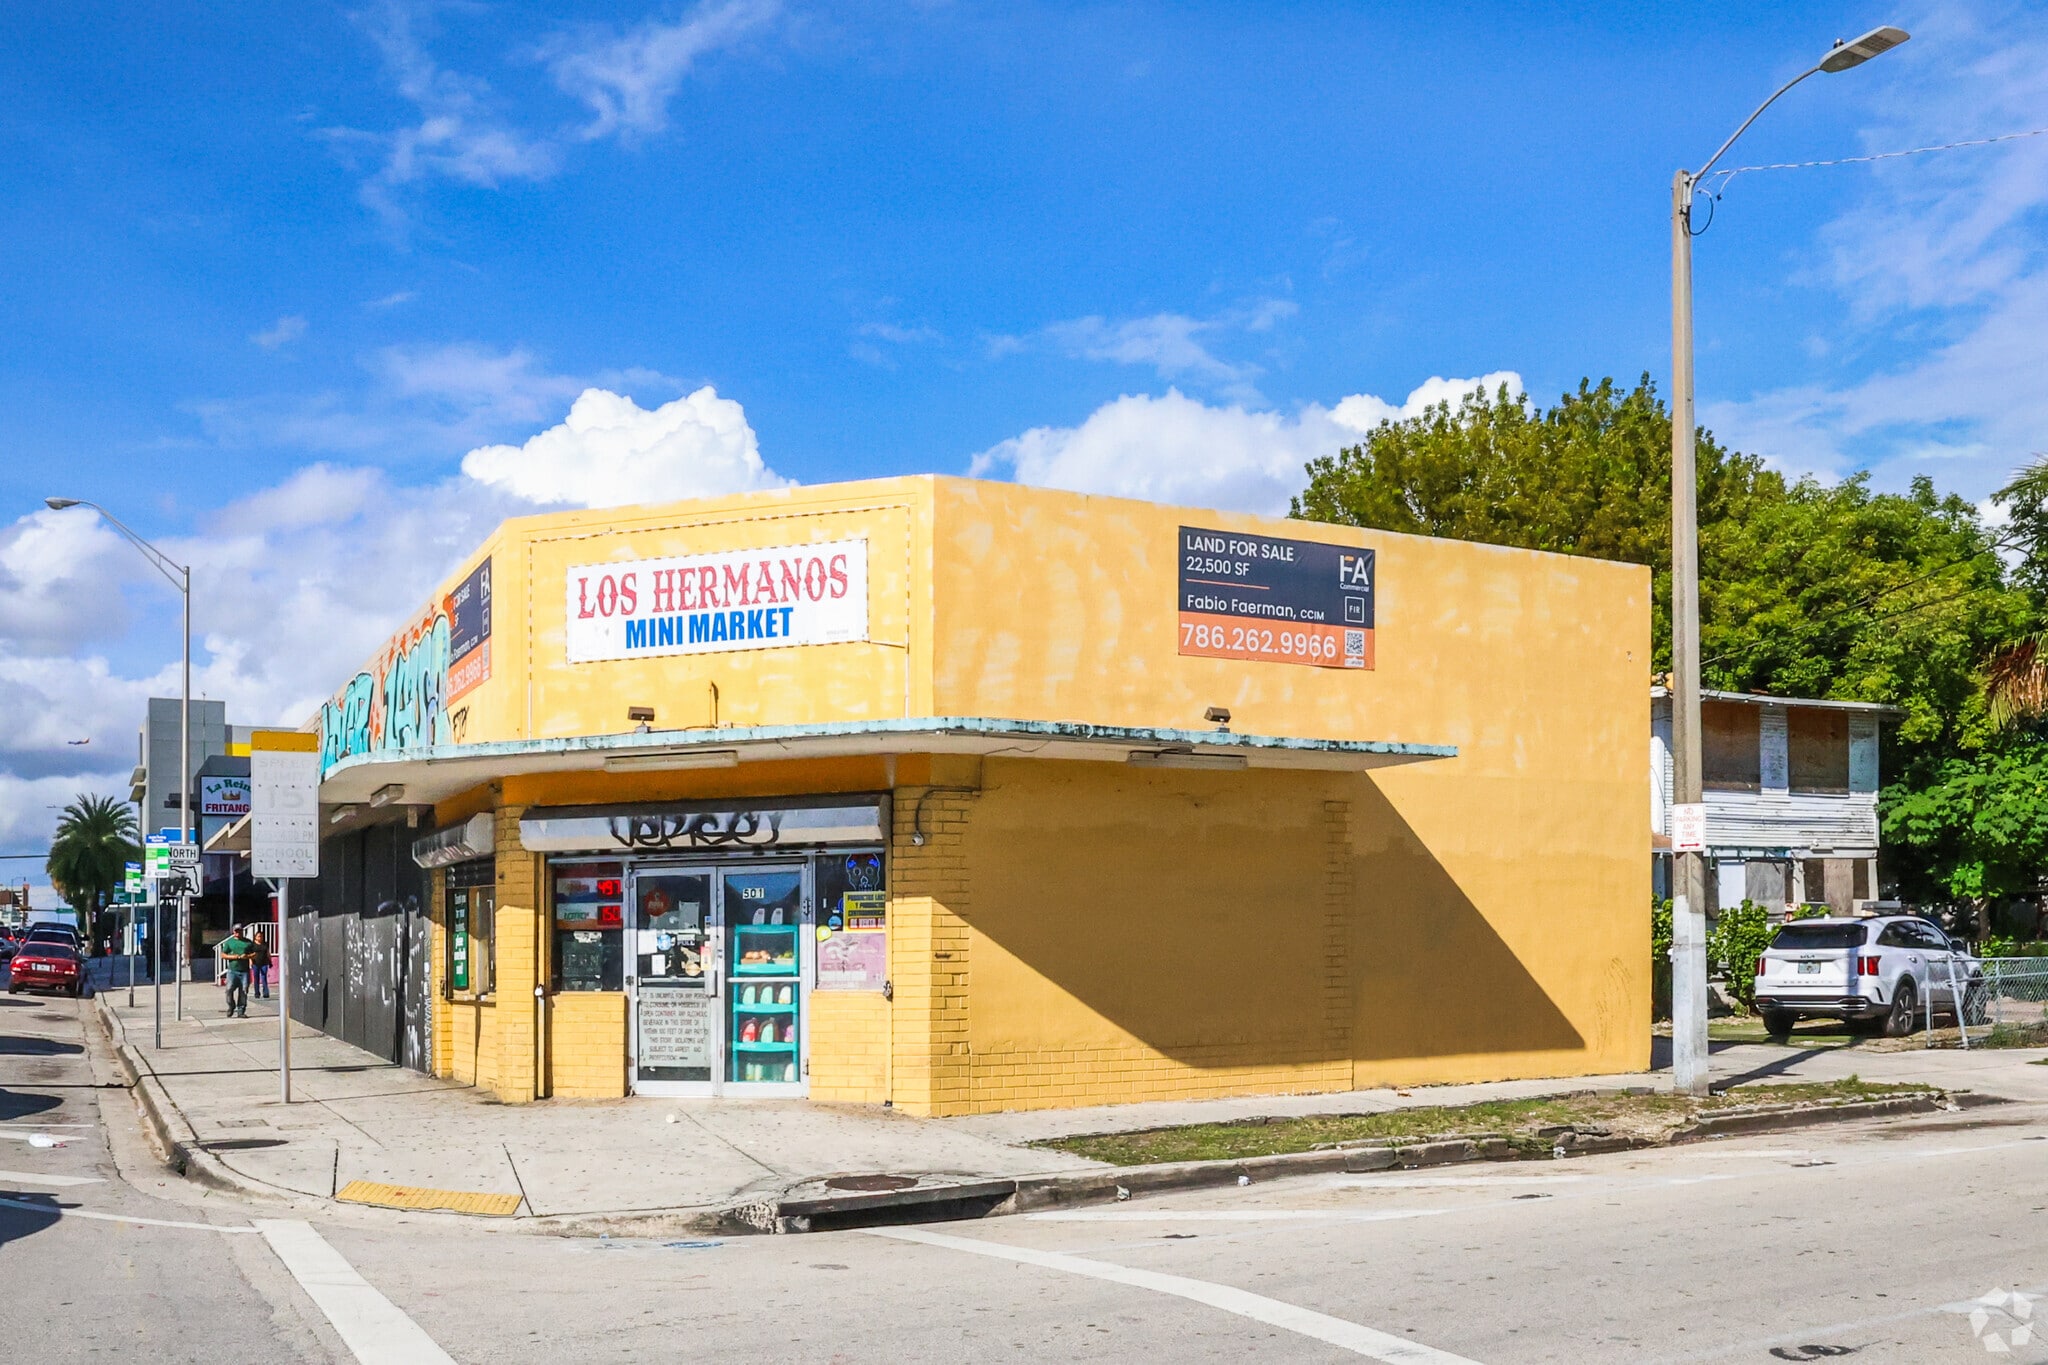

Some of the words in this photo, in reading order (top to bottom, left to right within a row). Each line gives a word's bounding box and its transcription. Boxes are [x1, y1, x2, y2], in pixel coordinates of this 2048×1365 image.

[1186, 534, 1226, 554] LAND
[1229, 540, 1258, 558] FOR
[1261, 544, 1294, 562] SALE
[1186, 556, 1231, 575] 22,500
[1234, 562, 1250, 577] SF
[1340, 555, 1369, 586] FA
[578, 573, 637, 619] LOS
[652, 554, 848, 613] HERMANOS
[1340, 583, 1370, 593] Commercial
[1187, 594, 1227, 611] Fabio
[1231, 599, 1297, 620] Faerman,
[1300, 609, 1325, 621] CCIM
[1349, 605, 1360, 614] FIR
[625, 616, 684, 649] MINI
[689, 607, 794, 643] MARKET
[1181, 622, 1337, 658] 786.262.9966
[206, 783, 222, 794] La
[266, 785, 304, 809] 15
[1684, 807, 1694, 815] NO
[1675, 815, 1703, 823] PARKING
[1680, 830, 1697, 838] TIME
[257, 847, 313, 858] SCHOOL
[264, 860, 306, 871] DAYS
[743, 888, 762, 898] 501
